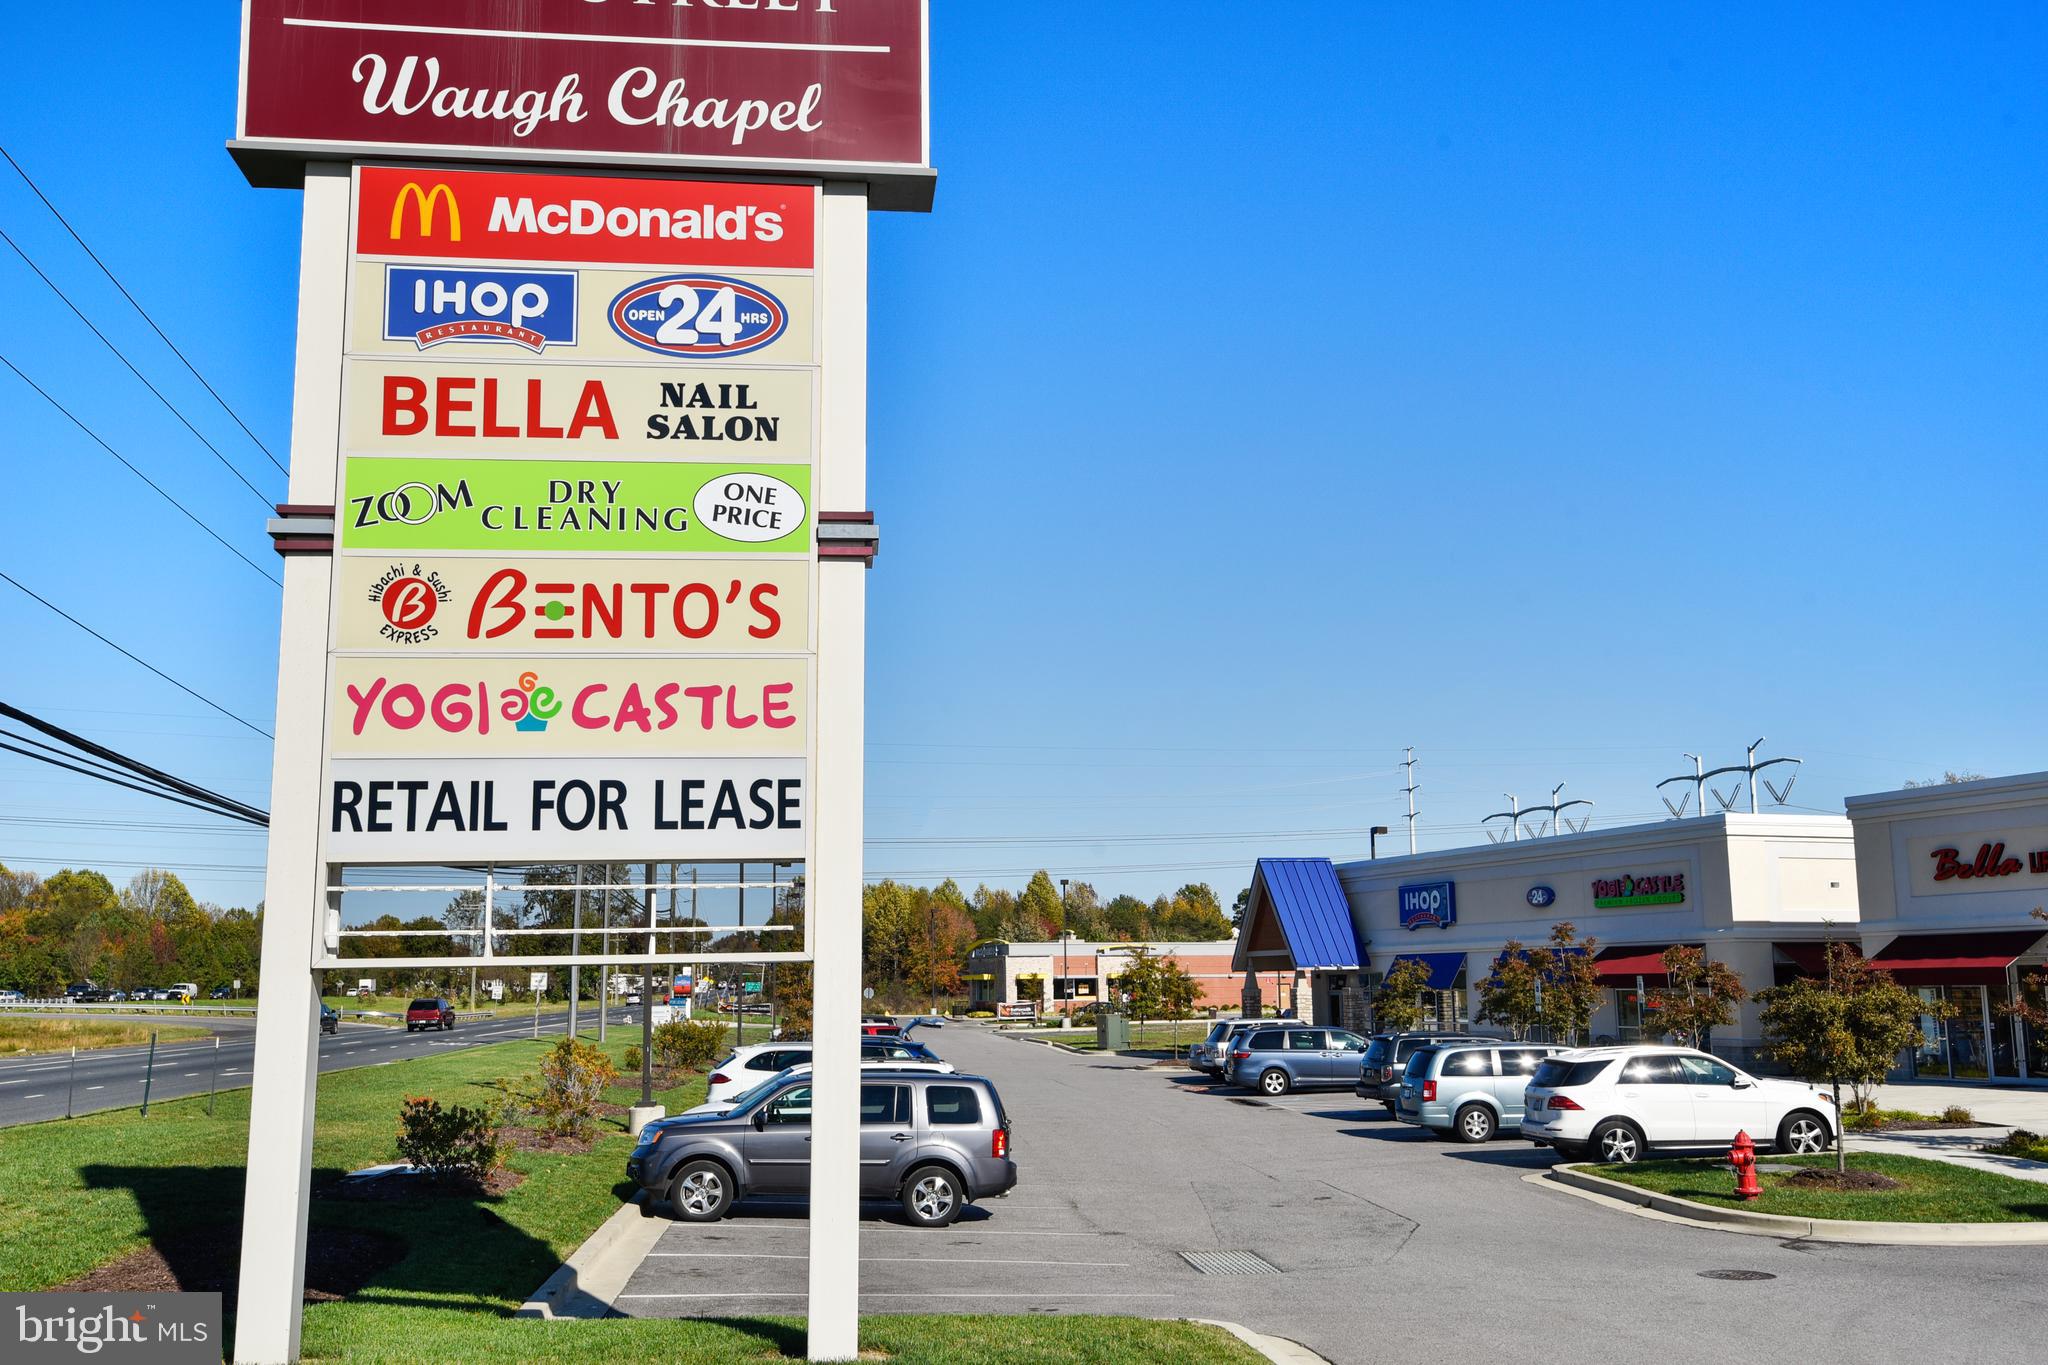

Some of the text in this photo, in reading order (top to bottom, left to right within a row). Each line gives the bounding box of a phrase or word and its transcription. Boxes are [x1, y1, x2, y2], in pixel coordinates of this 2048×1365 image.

[351, 53, 823, 145] Waugh Chapel
[487, 196, 784, 242] McDonald's
[628, 284, 768, 346] OPEN 24 HRS
[425, 324, 537, 342] RESTAURANT
[382, 376, 619, 439] BELLA
[659, 382, 757, 410] NAIL
[646, 414, 780, 442] SALON
[351, 479, 473, 528] ZOOM
[547, 480, 623, 504] DRY
[723, 482, 778, 506] ONE
[481, 506, 689, 532] CLEANING
[711, 505, 783, 530] PRICE
[368, 563, 452, 603] Hibachi & Sushi
[380, 623, 438, 645] EXPRESS
[347, 677, 796, 735] YOGI CASTLE
[332, 778, 801, 832] RETAIL FOR LEASE
[1930, 842, 2023, 881] Bella
[1532, 890, 1543, 903] 24
[1635, 873, 1684, 894] CASTLE
